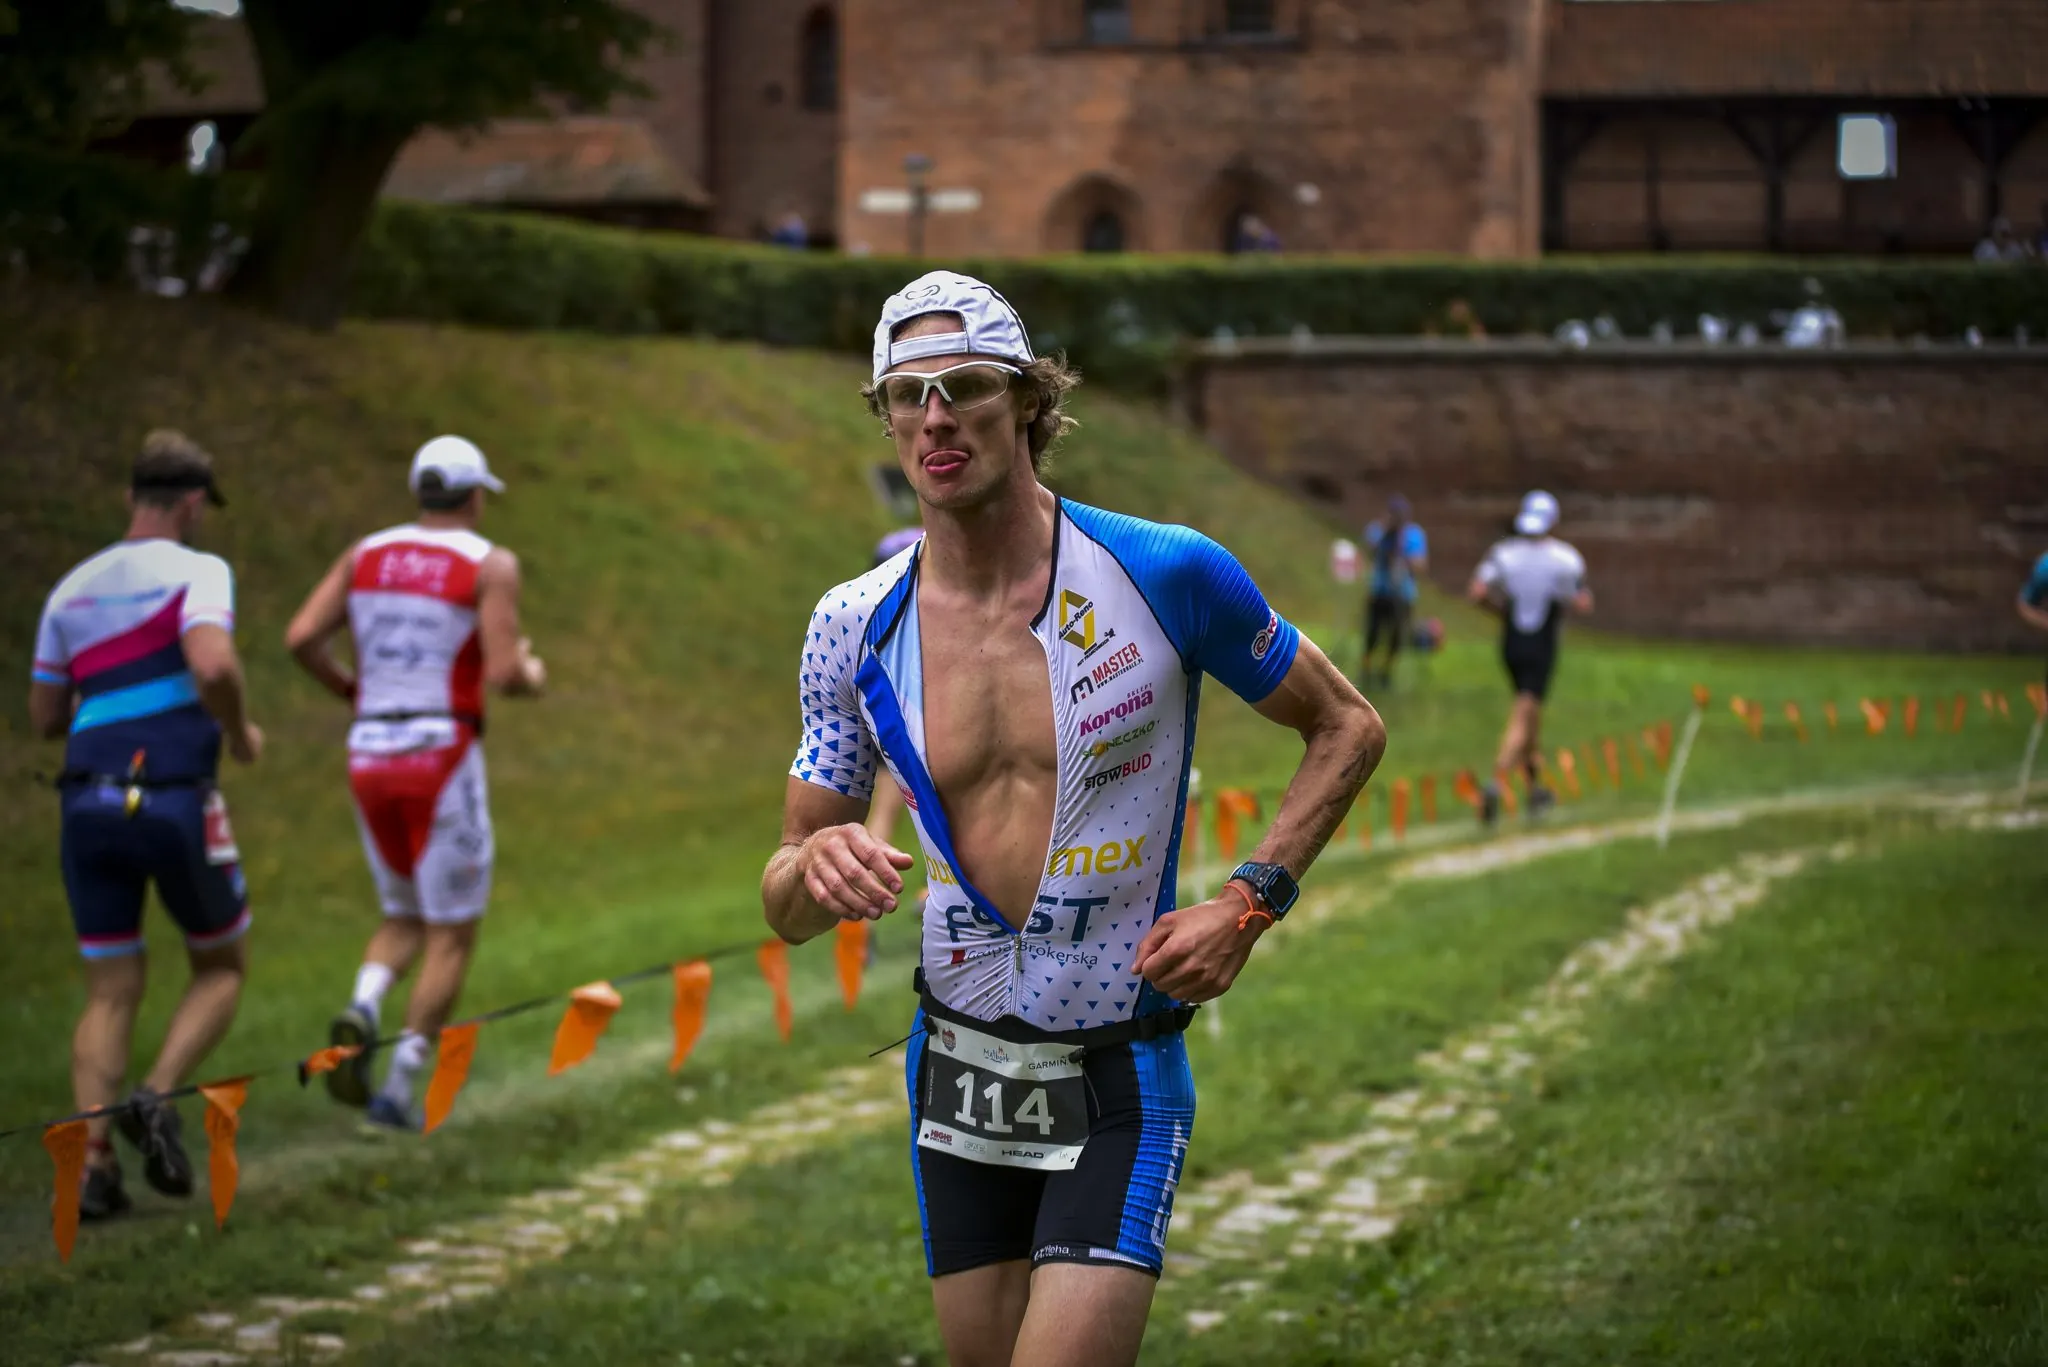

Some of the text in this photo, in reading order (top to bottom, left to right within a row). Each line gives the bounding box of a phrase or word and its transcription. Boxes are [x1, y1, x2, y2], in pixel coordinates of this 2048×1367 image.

[1059, 601, 1094, 640] Auto-Reno
[1092, 642, 1141, 684] MASTER
[1080, 690, 1153, 737] Korona
[1020, 941, 1098, 966] Brokerska
[1028, 1057, 1068, 1070] GARMIN
[955, 1071, 1055, 1135] 114
[1002, 1149, 1045, 1159] HEAD
